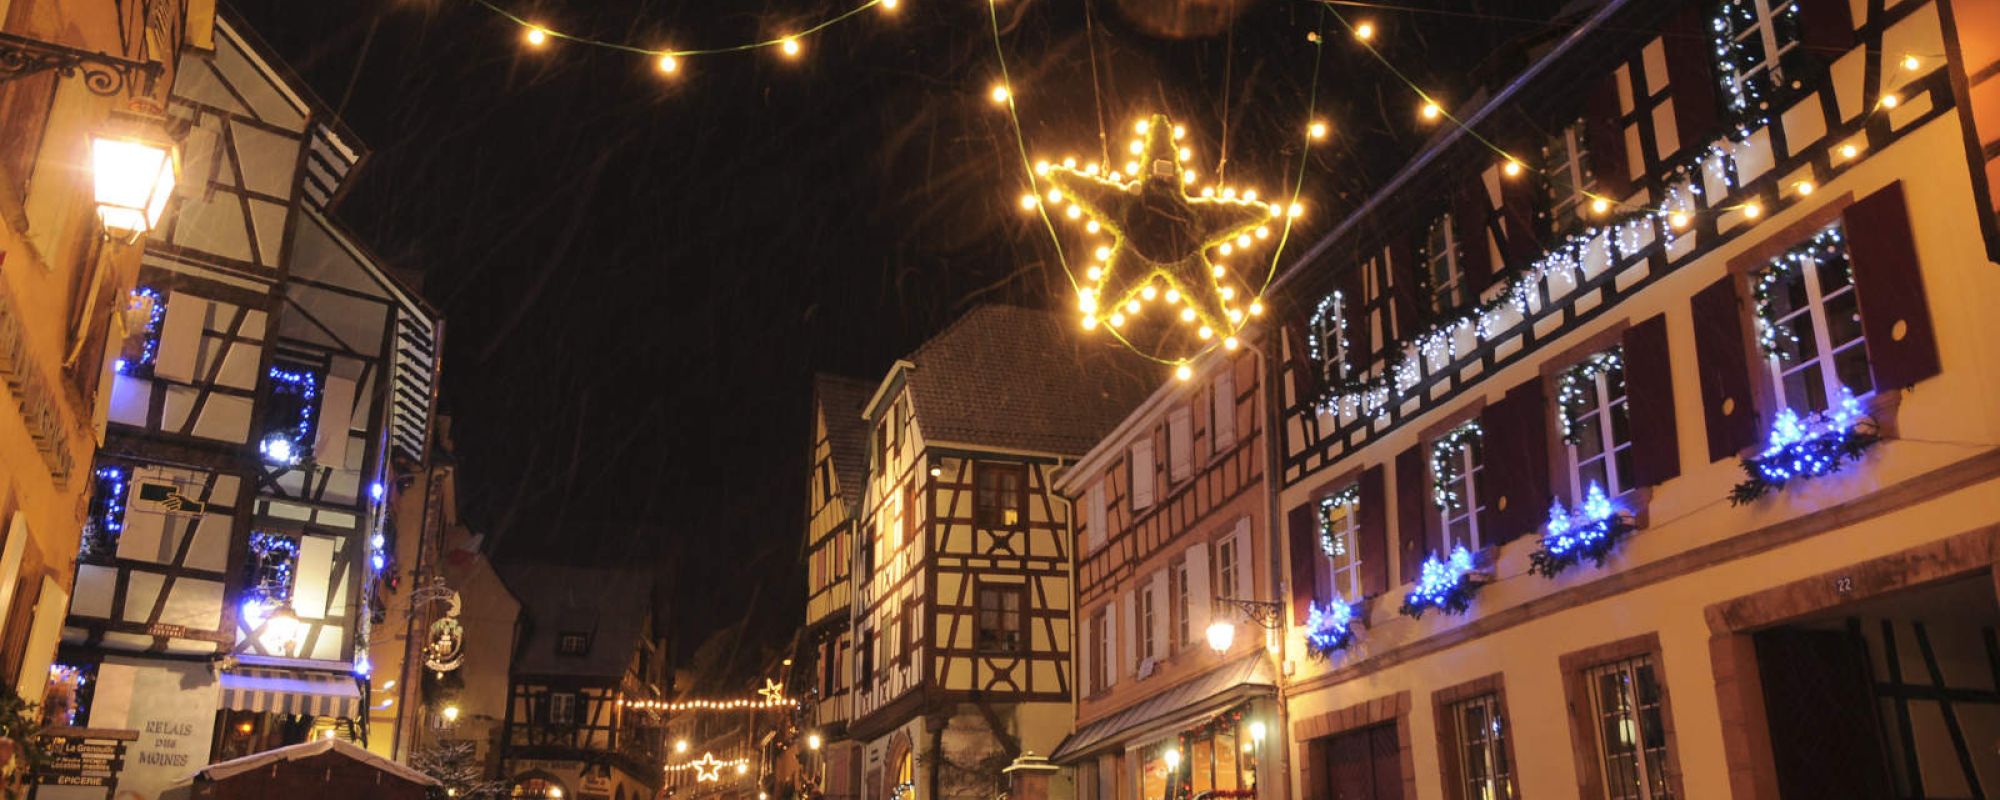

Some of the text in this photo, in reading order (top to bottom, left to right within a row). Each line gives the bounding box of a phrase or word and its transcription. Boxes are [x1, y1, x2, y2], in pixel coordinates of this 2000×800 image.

[1838, 578, 1851, 592] 22
[146, 720, 193, 736] RELAIS
[139, 751, 188, 767] MOINES
